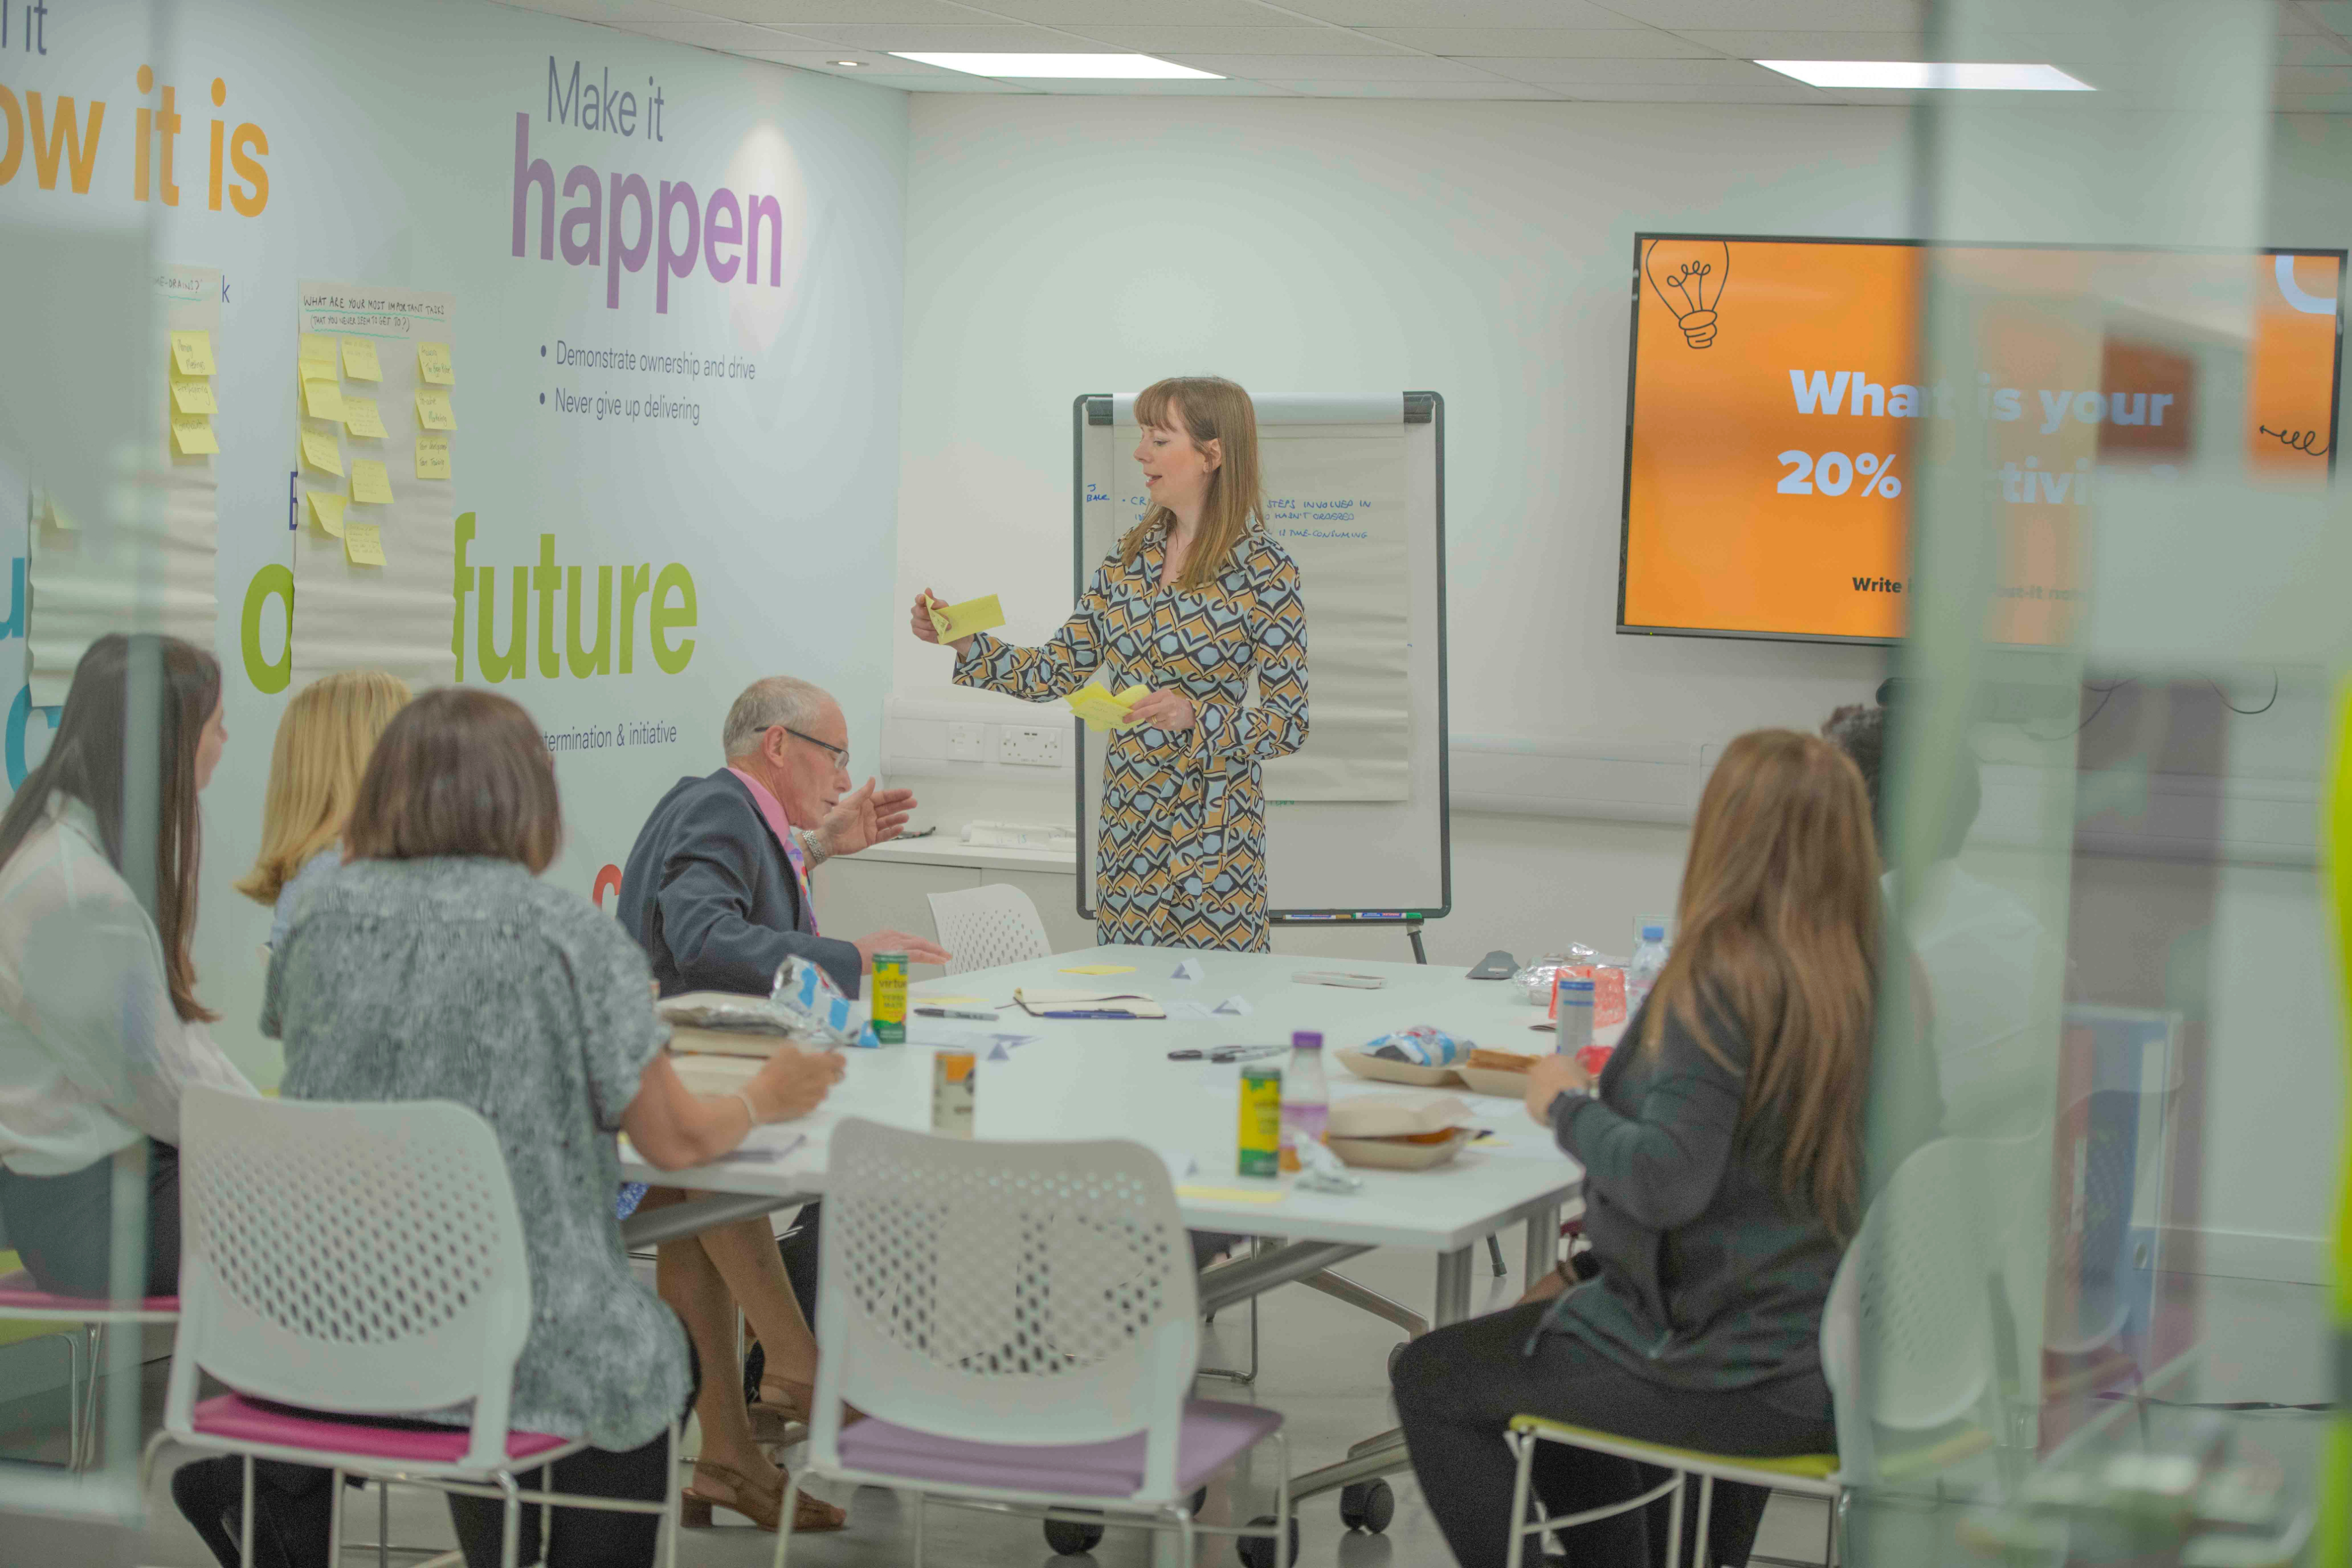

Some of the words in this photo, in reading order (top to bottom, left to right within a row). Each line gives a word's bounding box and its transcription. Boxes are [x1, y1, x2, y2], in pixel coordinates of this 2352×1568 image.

[547, 56, 636, 137] Make
[648, 76, 664, 142] it
[134, 64, 181, 207] it
[208, 77, 269, 217] is
[512, 112, 782, 315] happen
[304, 296, 327, 307] WHAT
[330, 297, 345, 309] ARE
[349, 298, 365, 310] YOUR
[368, 300, 385, 311] MOST
[388, 302, 423, 313] IMPORTANT
[425, 305, 444, 315] TASKS
[328, 316, 338, 324] YOU
[339, 316, 355, 326] NEVER
[357, 316, 370, 326] SEEM
[371, 316, 378, 326] TO
[379, 316, 391, 326] GET
[556, 340, 636, 371] Demonstrate
[640, 351, 700, 381] ownership
[703, 354, 725, 378] and
[728, 354, 756, 380] drive
[555, 387, 593, 415] Never
[597, 391, 622, 420] give
[625, 400, 640, 423] up
[644, 394, 700, 426] delivering
[1977, 372, 2022, 422] is
[2038, 389, 2174, 435] your
[1777, 450, 1902, 499] 20%
[1267, 499, 1295, 509] STEPS
[1303, 500, 1354, 509] INVOLVED
[1360, 500, 1371, 508] IN
[451, 512, 698, 683] future
[1852, 576, 1902, 594] Write
[544, 725, 612, 752] termination
[617, 723, 625, 746] &
[629, 720, 677, 745] initiative
